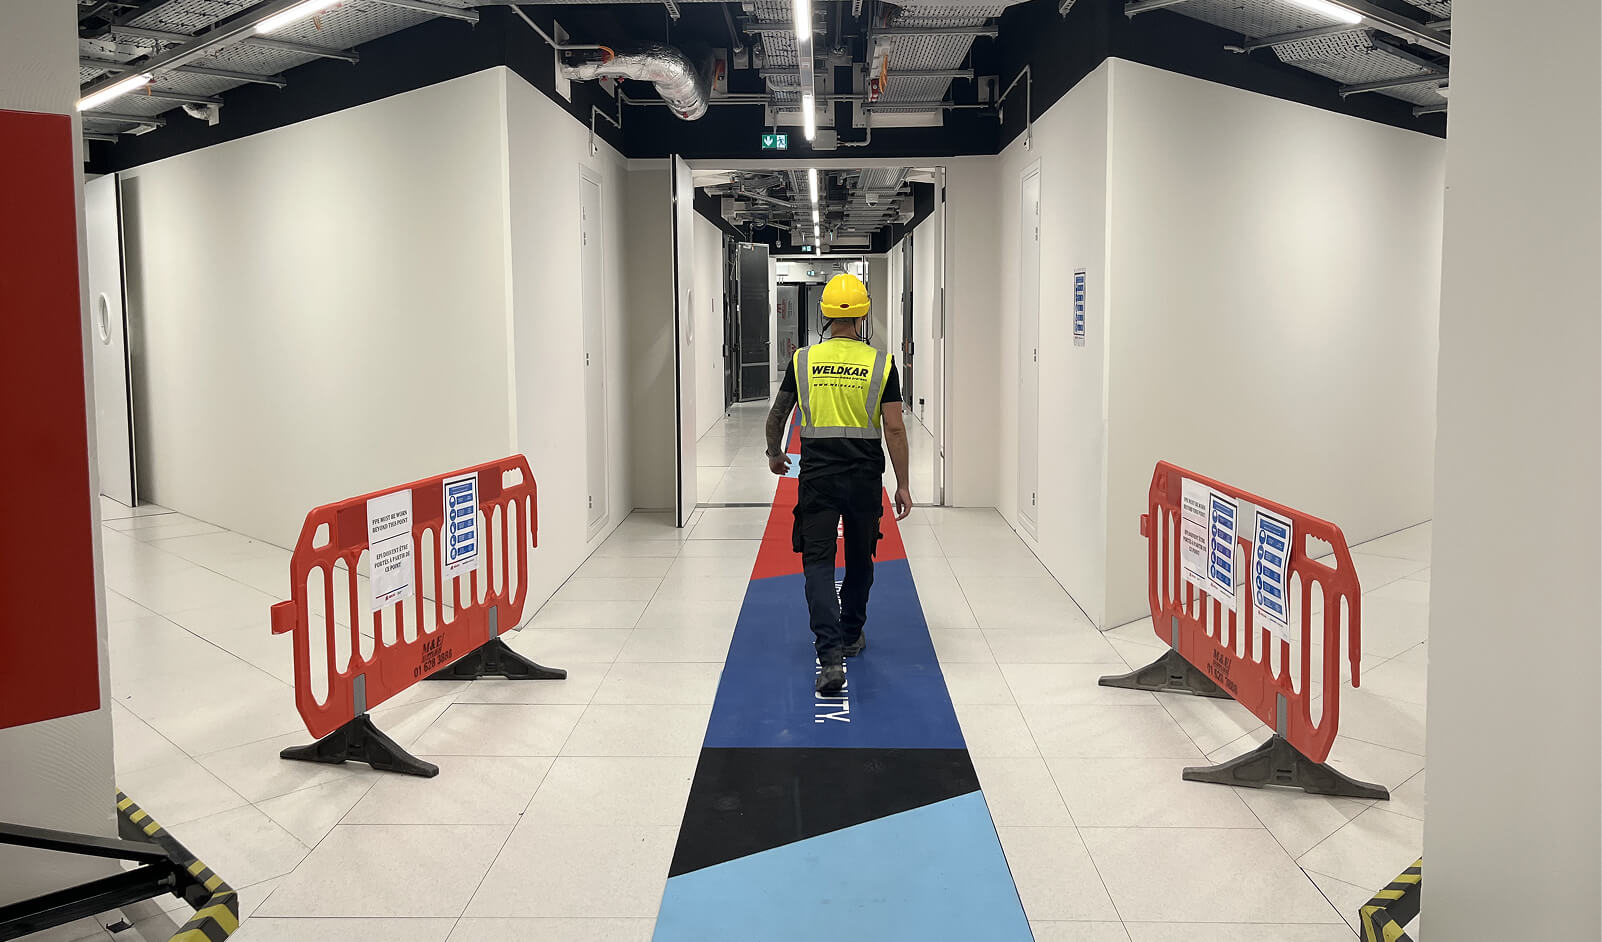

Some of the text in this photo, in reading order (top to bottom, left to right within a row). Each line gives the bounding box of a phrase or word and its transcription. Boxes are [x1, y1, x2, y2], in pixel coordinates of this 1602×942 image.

[812, 365, 869, 377] WELDKAR
[372, 517, 380, 525] PPE
[380, 514, 391, 523] MUST
[372, 523, 389, 533] BEYOND
[396, 517, 408, 526] POINT
[383, 547, 399, 558] DOIVENT
[392, 553, 405, 562] PARTIR
[390, 562, 402, 570] POINT
[413, 665, 422, 678] 01
[423, 657, 436, 672] 628
